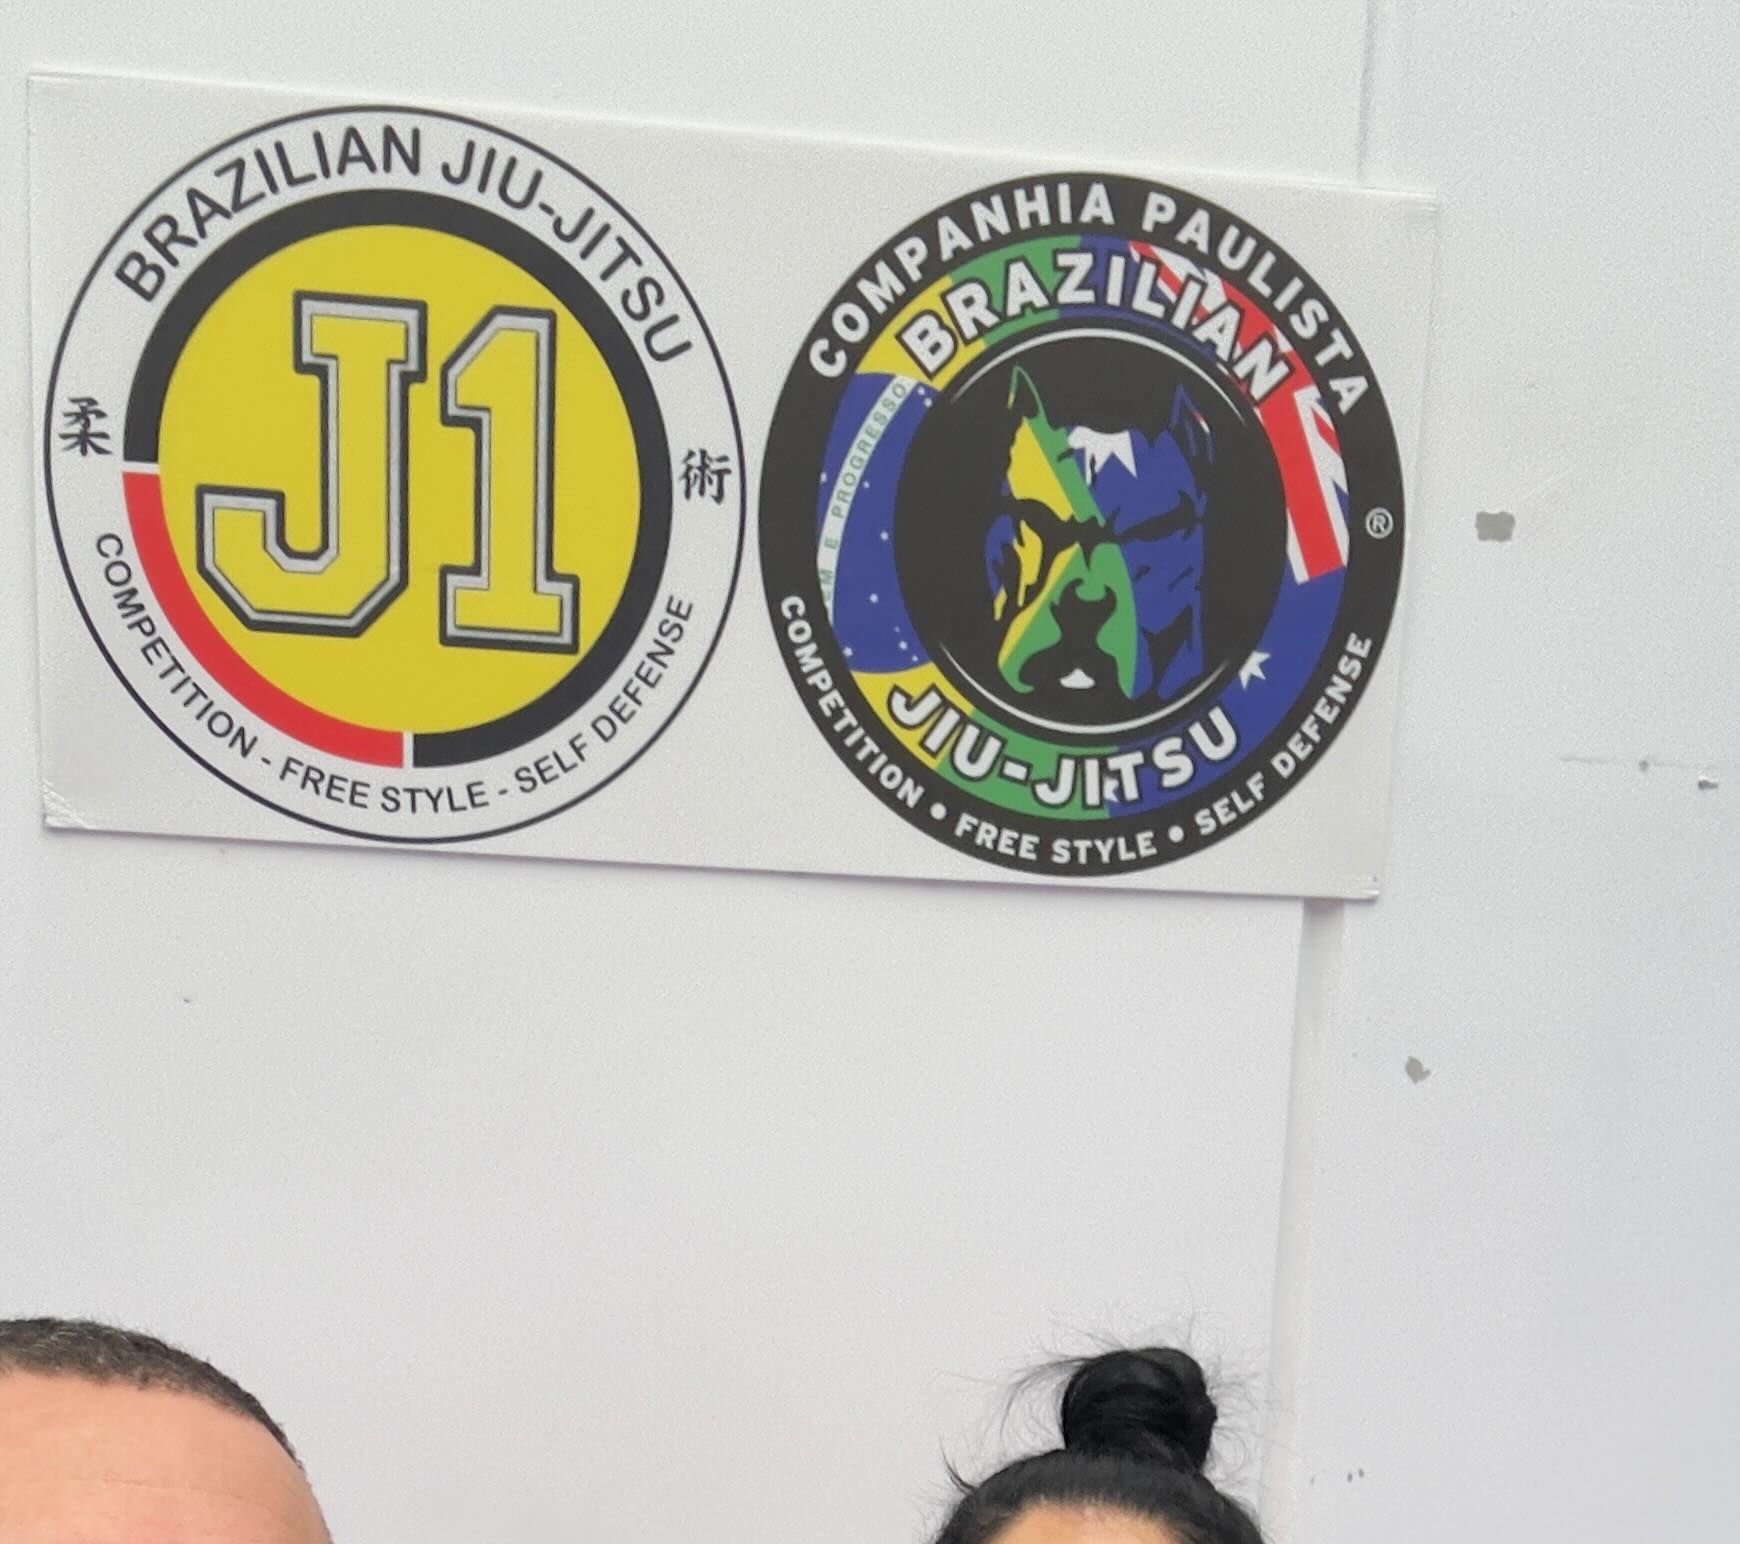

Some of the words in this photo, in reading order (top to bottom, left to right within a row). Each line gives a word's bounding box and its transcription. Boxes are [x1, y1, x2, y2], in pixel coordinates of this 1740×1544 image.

[114, 125, 421, 302] BRAZILIAN
[442, 139, 694, 364] JIU-JITSU
[808, 183, 1116, 379] COMPANHIA
[1142, 191, 1370, 414] PAULISTA
[901, 251, 1291, 401] BRAZILIAN
[59, 396, 112, 456] 柔
[196, 290, 580, 655] J1
[679, 449, 732, 505] 術
[831, 382, 907, 519] PROGRESSO
[96, 533, 260, 760] COMPETITION
[279, 756, 370, 809] FREE
[380, 779, 490, 814] STYLE
[514, 739, 591, 795] SELF
[591, 594, 694, 751] DEFENSE
[780, 595, 925, 808] COMPETITION
[954, 817, 1038, 862] FREE
[1052, 832, 1158, 866] STYLE
[1195, 777, 1270, 836] SELF
[1271, 634, 1374, 776] DEFENSE
[891, 686, 1240, 808] JIU-JITSU
